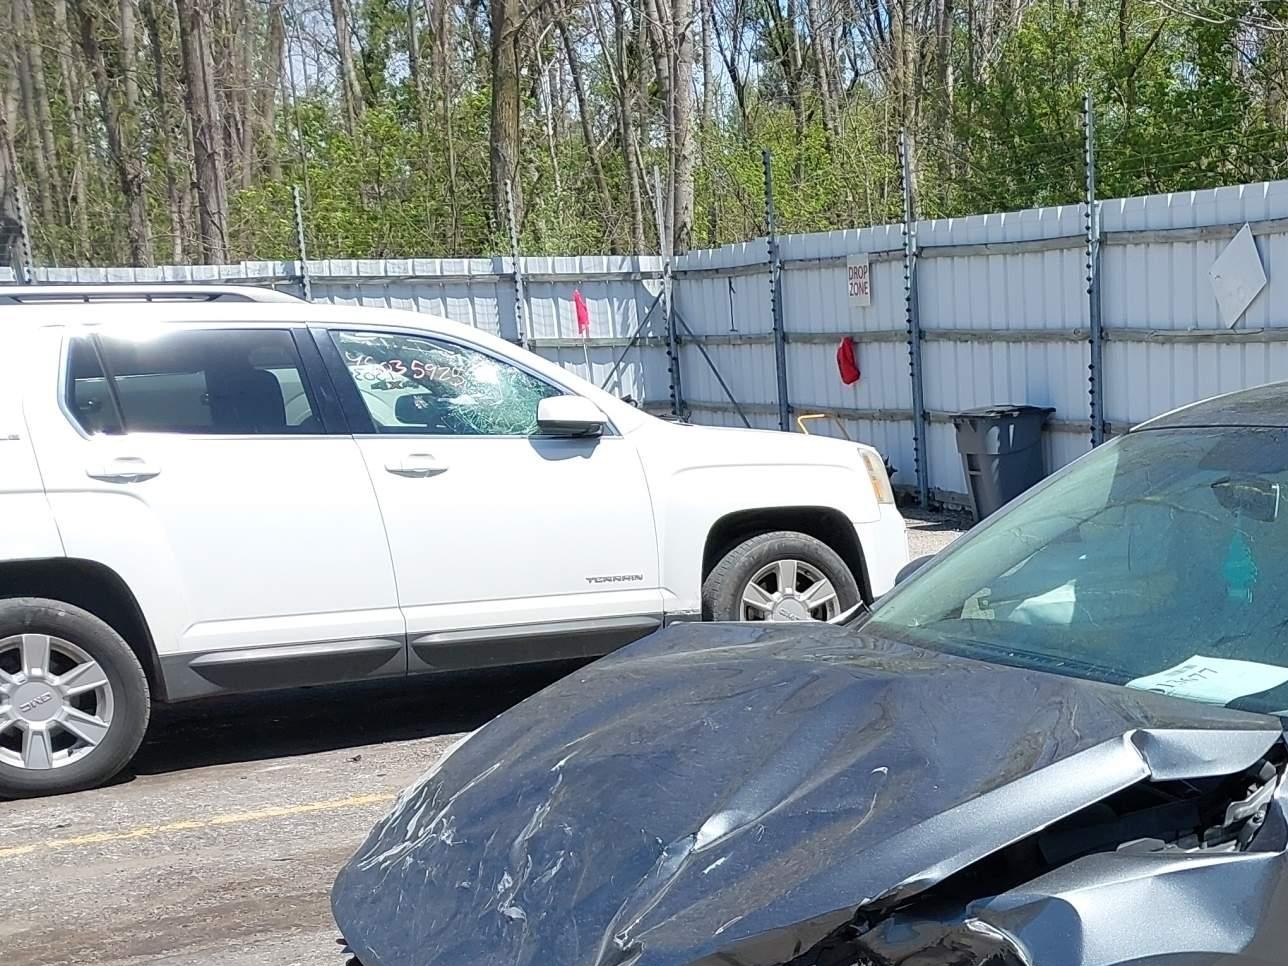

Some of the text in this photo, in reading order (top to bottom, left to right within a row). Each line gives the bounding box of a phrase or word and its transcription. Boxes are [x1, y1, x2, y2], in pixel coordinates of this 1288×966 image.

[848, 265, 868, 281] DROP
[849, 281, 869, 297] ZONE
[585, 574, 643, 584] TERRAIN
[20, 691, 52, 713] GMC
